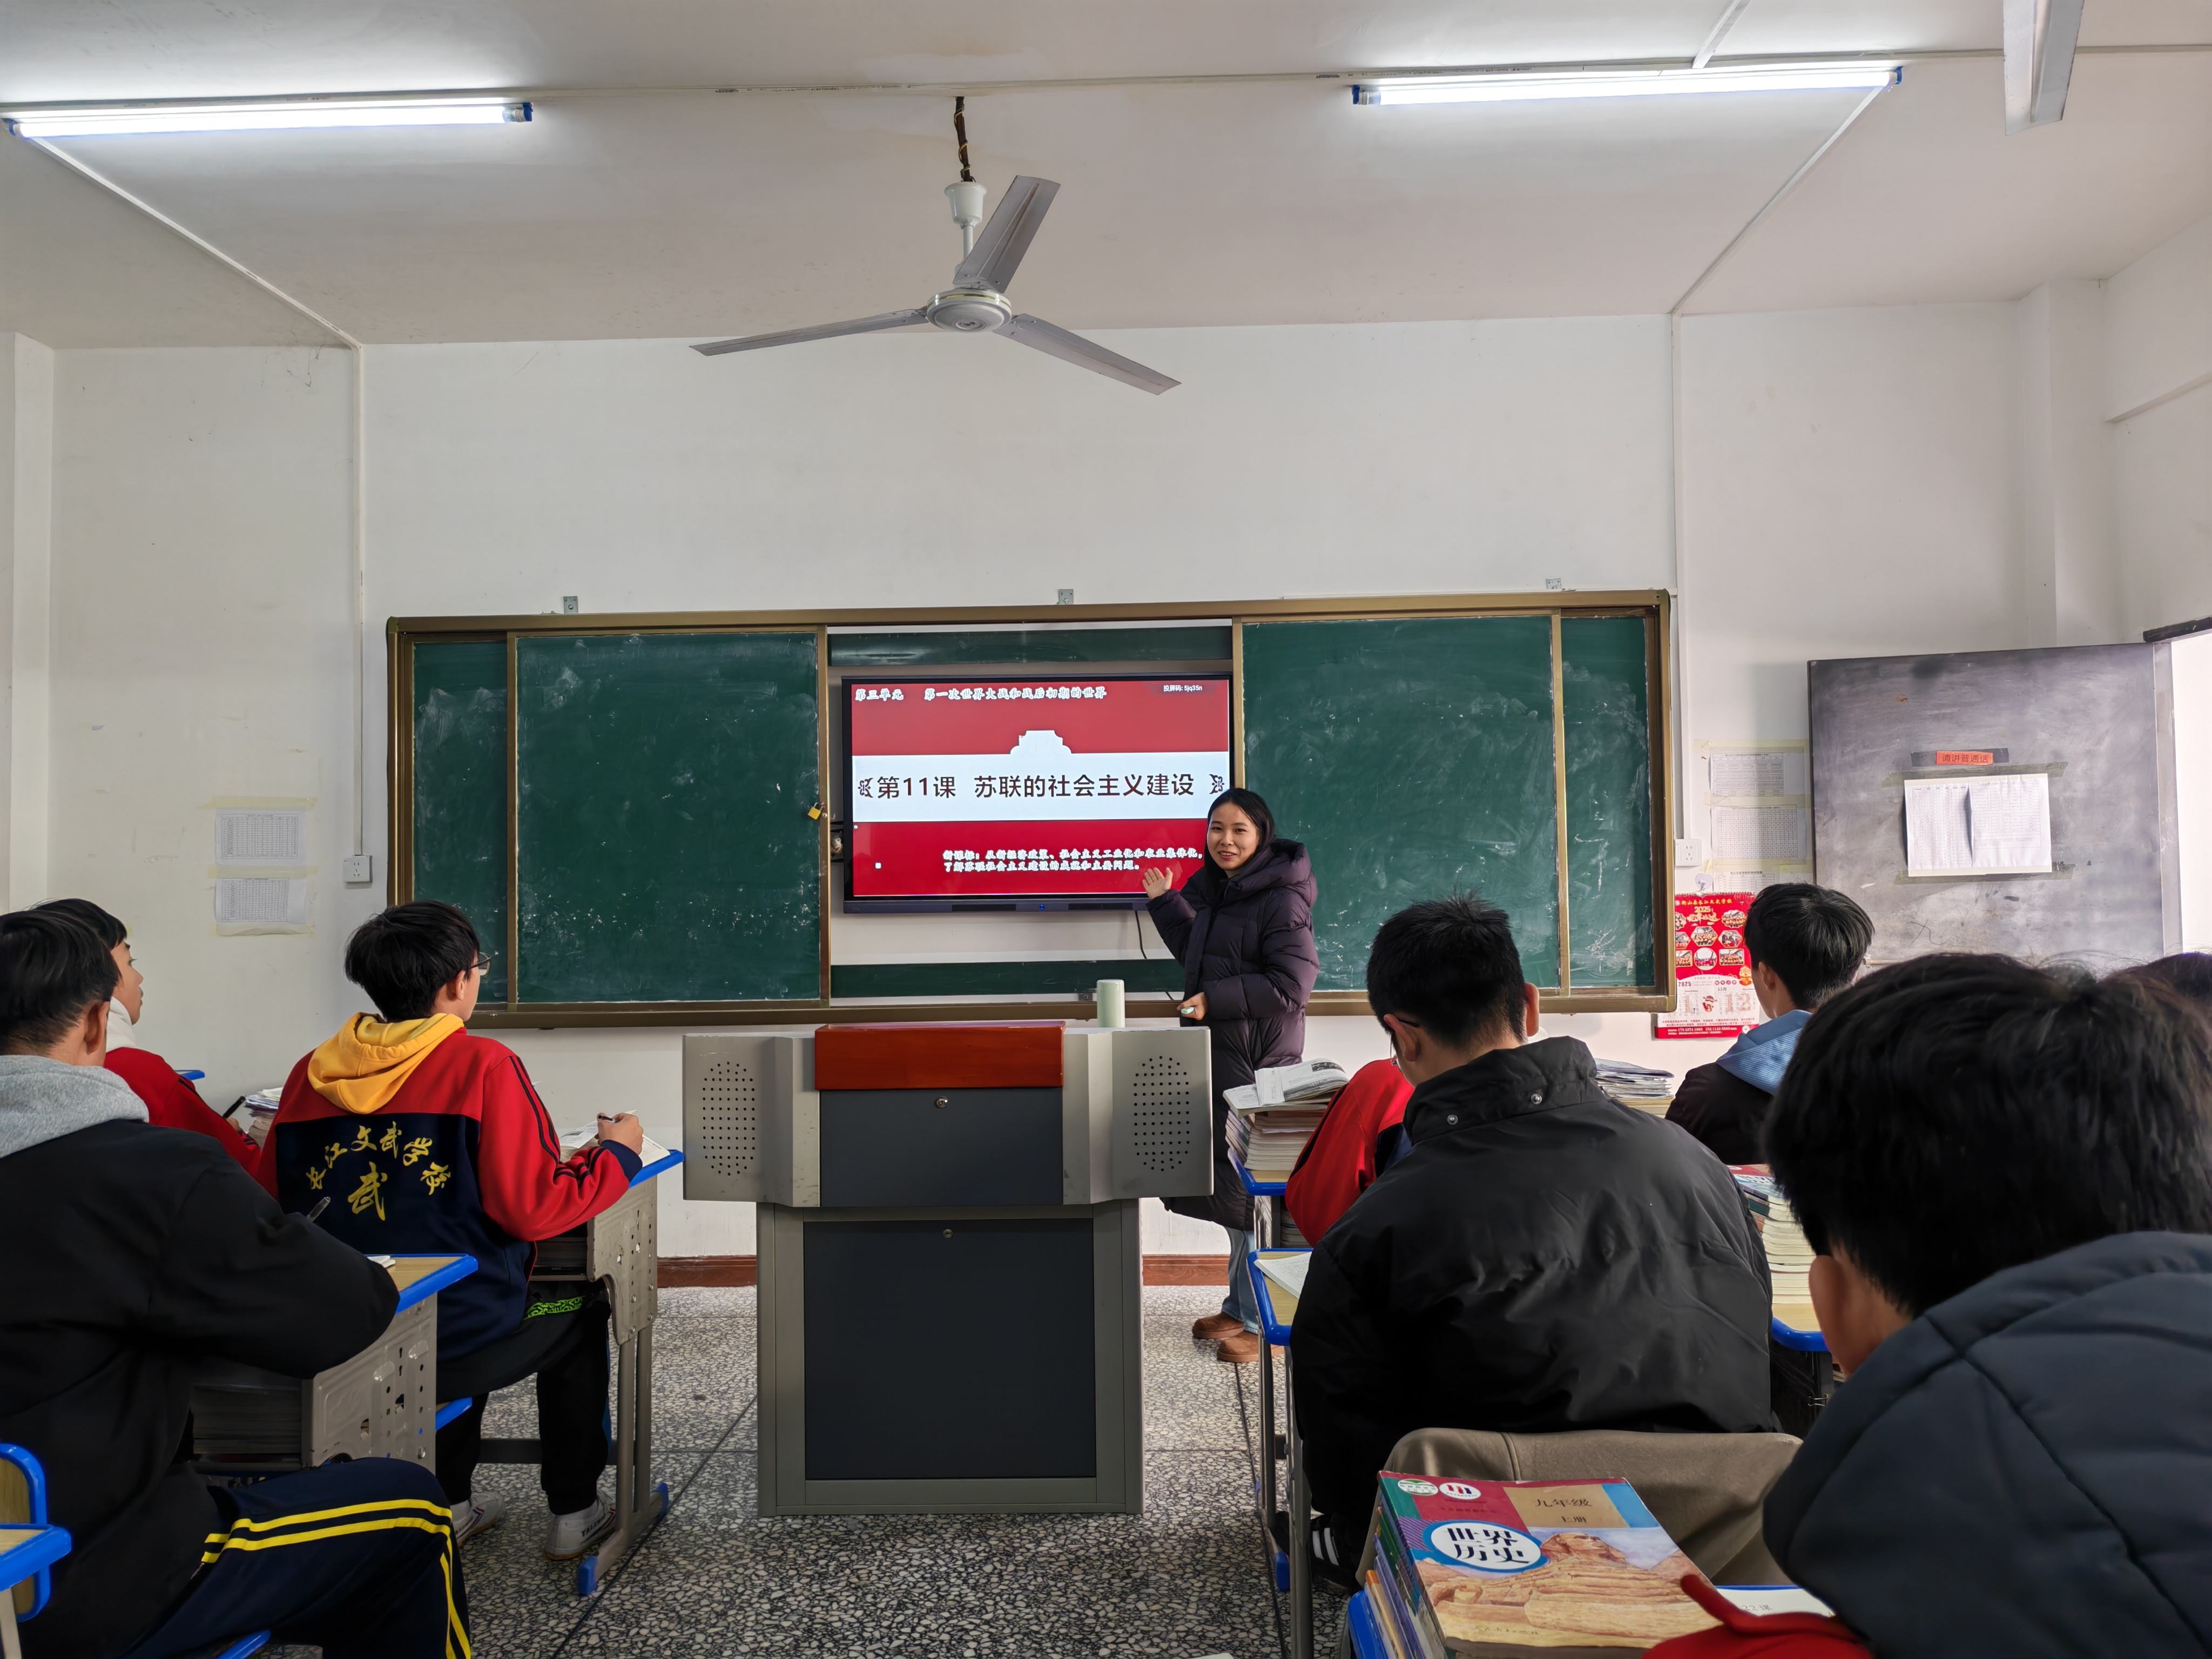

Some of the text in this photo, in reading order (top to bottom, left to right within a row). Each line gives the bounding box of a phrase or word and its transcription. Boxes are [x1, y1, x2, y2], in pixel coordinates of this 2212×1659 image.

[855, 686, 1107, 702] 第三单元 第一次世界大战和战后初期的世界
[1941, 753, 1989, 763] 请讲普通话
[877, 773, 1195, 800] 第11课 苏联的社会主义建设
[347, 1161, 388, 1221] 武
[1534, 1498, 1592, 1508] 九年级
[1446, 1527, 1518, 1546] 世界
[1454, 1542, 1530, 1564] 历史
